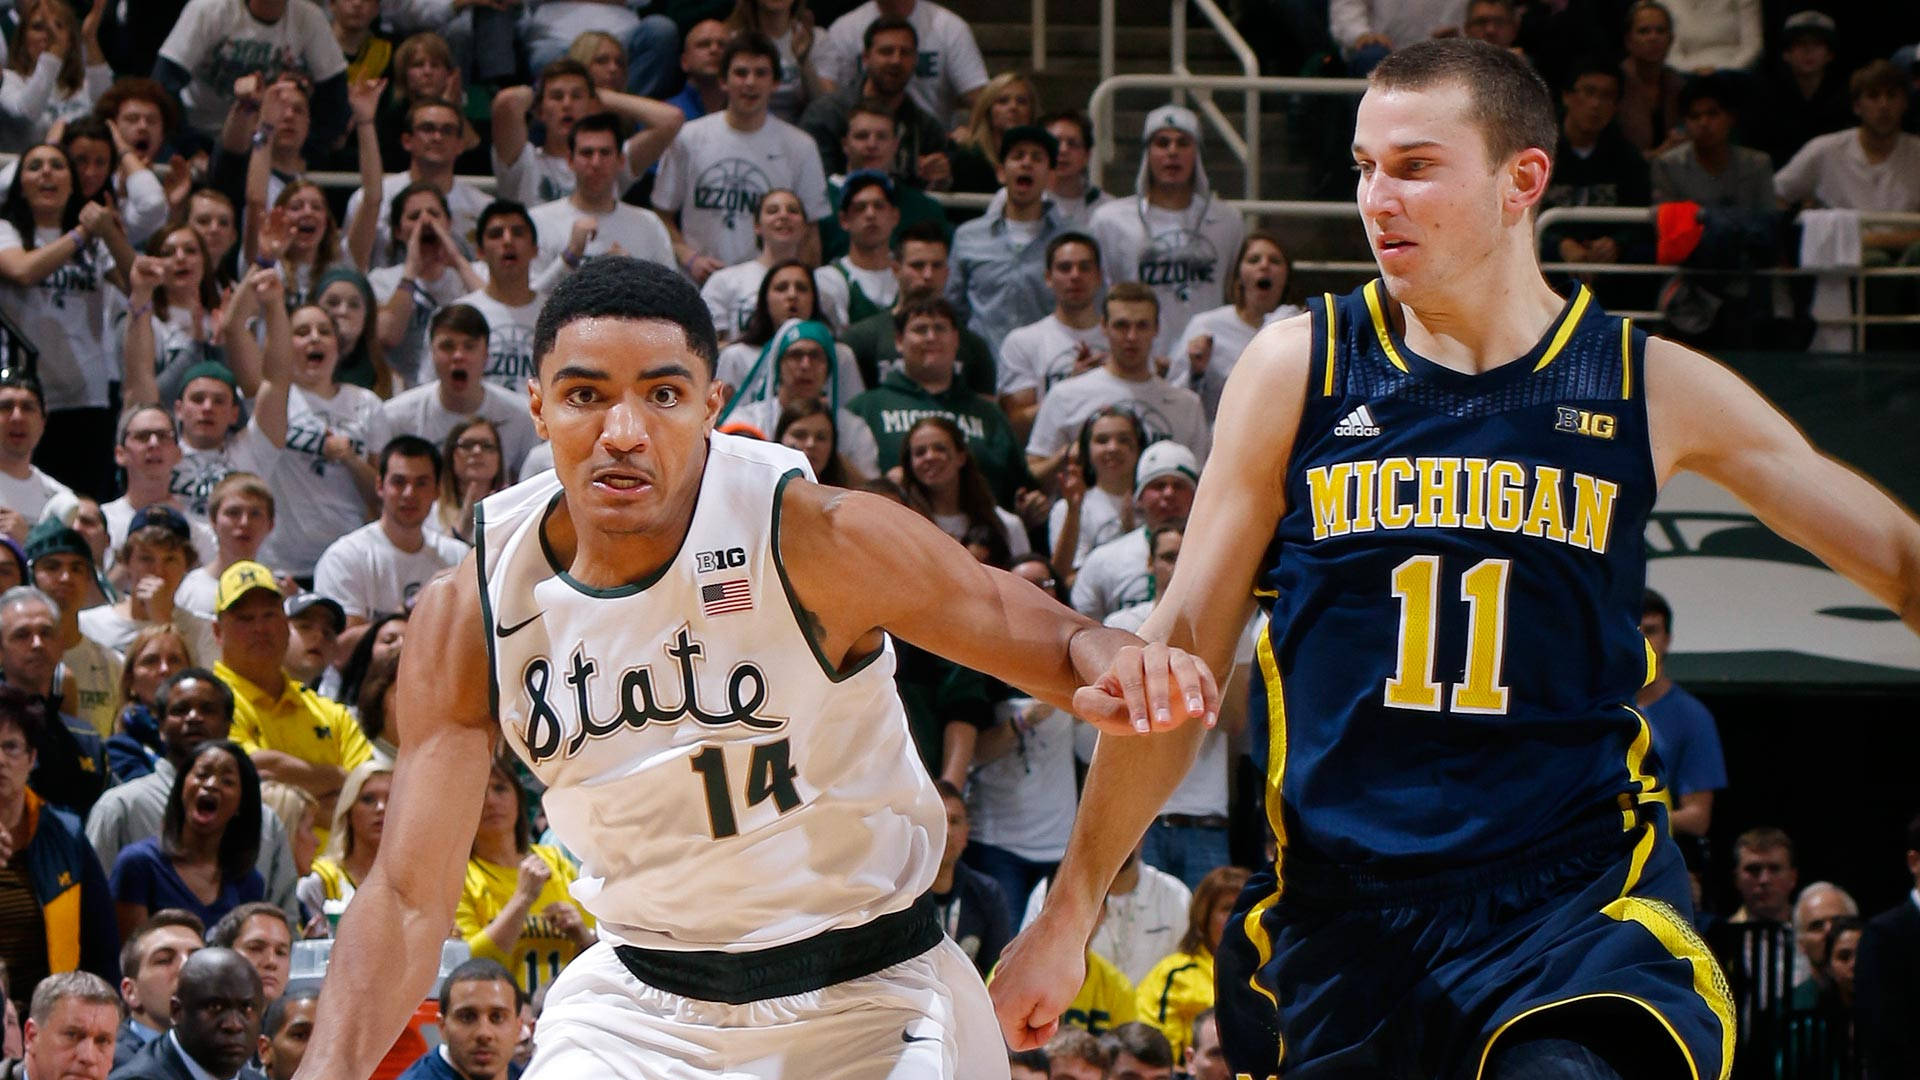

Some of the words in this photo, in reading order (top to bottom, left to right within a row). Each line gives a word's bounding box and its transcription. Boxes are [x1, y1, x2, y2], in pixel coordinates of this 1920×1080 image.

[695, 186, 762, 213] IZZON
[1334, 425, 1380, 437] adidas
[1307, 457, 1618, 554] MICHIGAN
[1384, 555, 1510, 714] 11
[517, 623, 790, 766] State
[690, 737, 803, 841] 14
